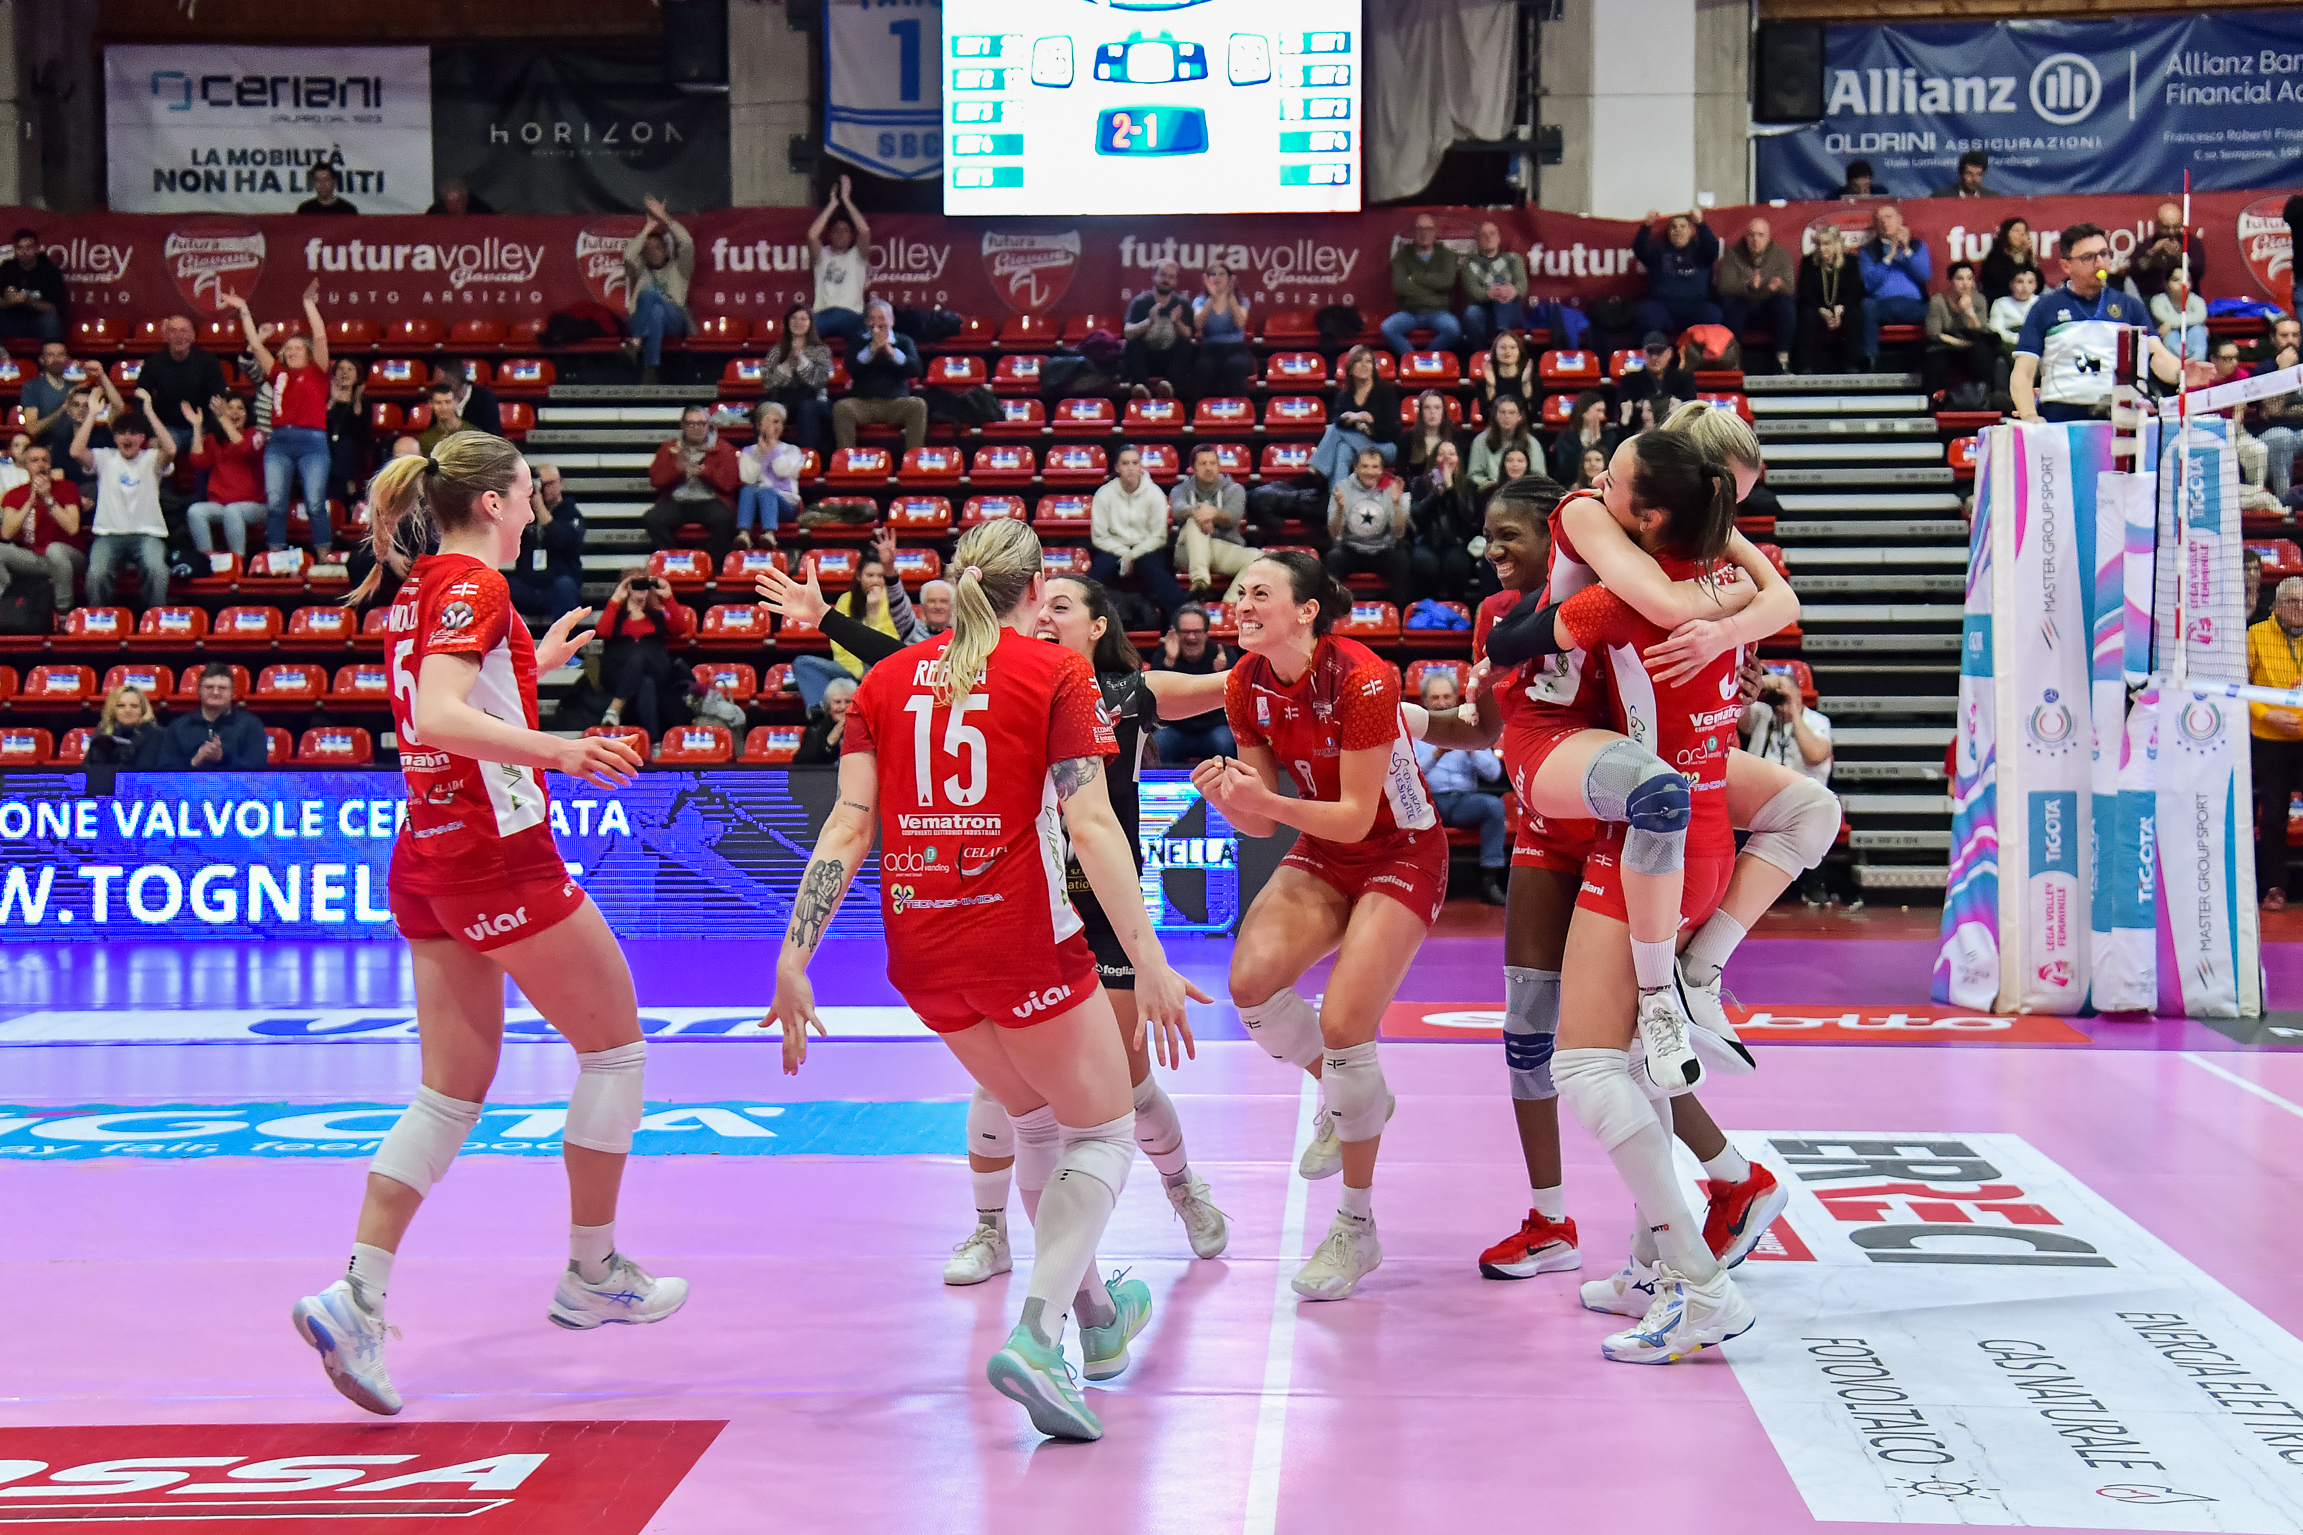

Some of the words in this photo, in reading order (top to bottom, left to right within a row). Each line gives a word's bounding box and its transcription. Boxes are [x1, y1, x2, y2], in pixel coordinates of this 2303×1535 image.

[889, 18, 921, 102] 1
[2164, 51, 2254, 76] Allianz
[1828, 67, 2017, 115] Allianz
[2165, 79, 2272, 106] Financial
[1112, 111, 1157, 149] 2-1
[1825, 131, 1938, 154] OLDRINI
[1945, 136, 2102, 152] ASSICURAZIONI
[191, 148, 221, 167] LA
[227, 143, 345, 167] MOBILITÀ
[153, 169, 227, 193] NON
[235, 169, 282, 193] HA
[289, 169, 384, 193] LIITI
[327, 290, 399, 304] USTO
[2040, 453, 2054, 500] SPORT
[2041, 503, 2056, 555] GROUP
[2042, 557, 2057, 612] MASTER
[1689, 704, 1746, 727] Vematro
[903, 693, 989, 807] 15
[0, 801, 98, 839] ONE
[112, 800, 325, 840] VALVOLE
[897, 813, 1002, 830] Vematron
[2195, 791, 2209, 837] SPORT
[2197, 840, 2211, 892] GROUP
[2044, 881, 2056, 922] VOLLEY
[2056, 885, 2067, 947] FEMMINILE
[463, 906, 529, 942] viar
[2045, 925, 2056, 952] LEGA
[2198, 895, 2212, 952] MASTER
[1977, 1338, 2067, 1371] GAS
[2116, 1312, 2251, 1377] ENERGIA
[1801, 1337, 1956, 1465] FOTOVOLTAICO
[2013, 1374, 2167, 1471] NATURALE
